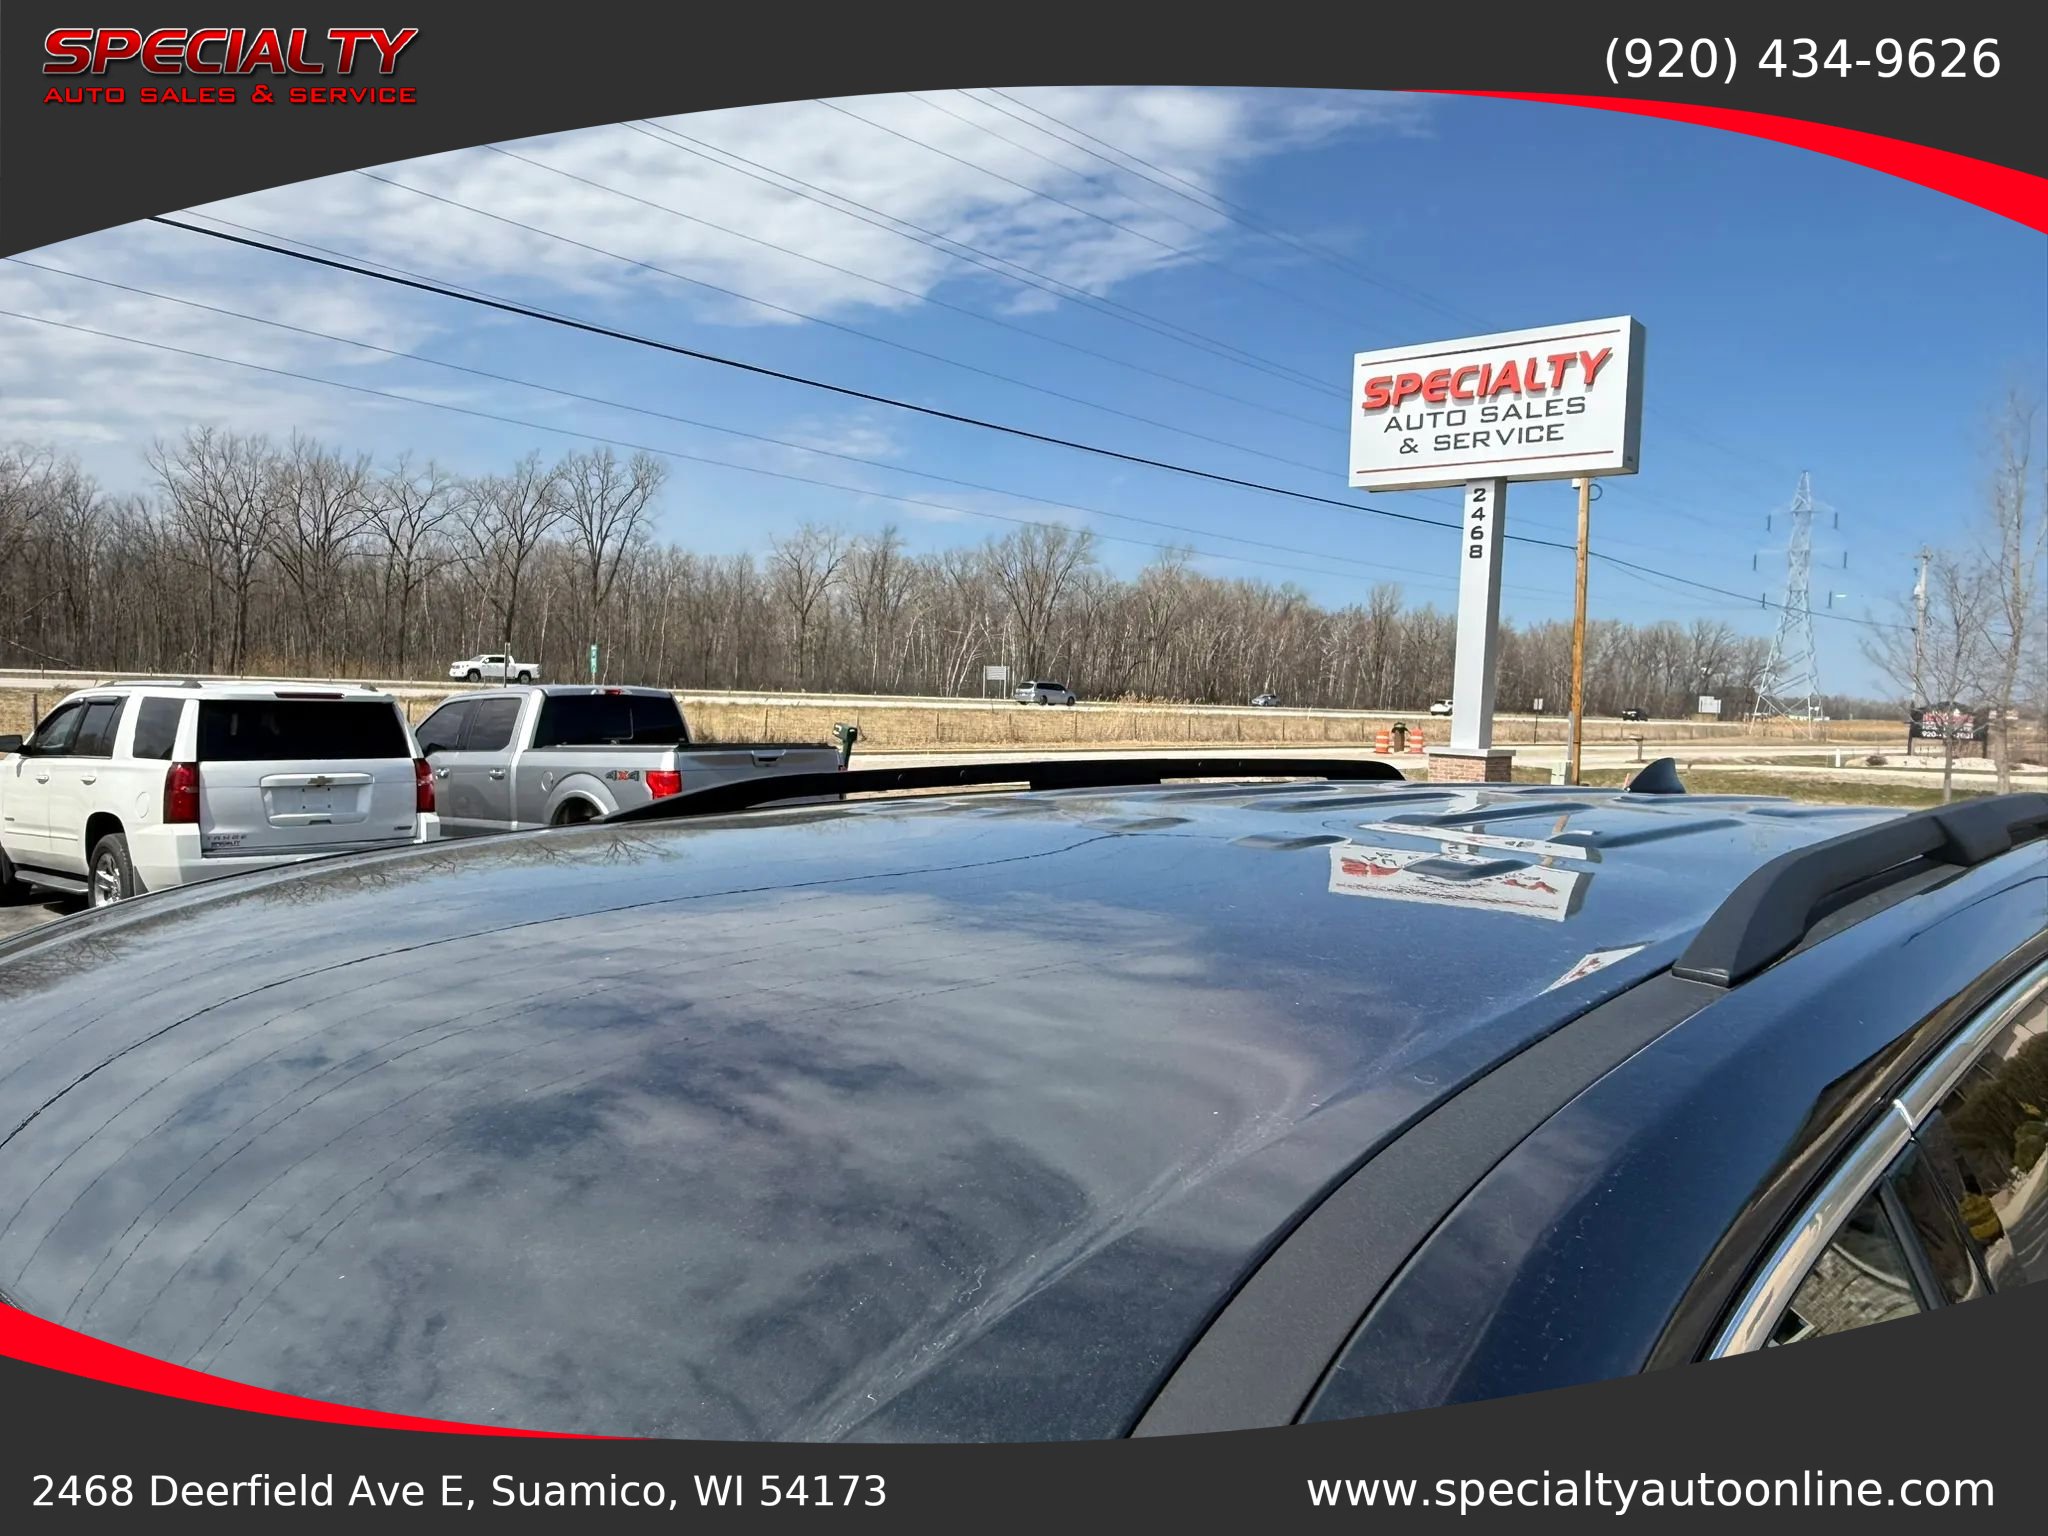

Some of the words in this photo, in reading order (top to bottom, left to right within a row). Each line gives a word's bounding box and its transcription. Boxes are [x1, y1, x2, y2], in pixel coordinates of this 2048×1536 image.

[1362, 347, 1612, 411] SPECIALTY
[1384, 409, 1466, 433] AUTO
[1480, 396, 1587, 422] SALES
[1399, 437, 1419, 455] &
[1433, 423, 1566, 451] SERVICE
[1468, 487, 1487, 559] 2468
